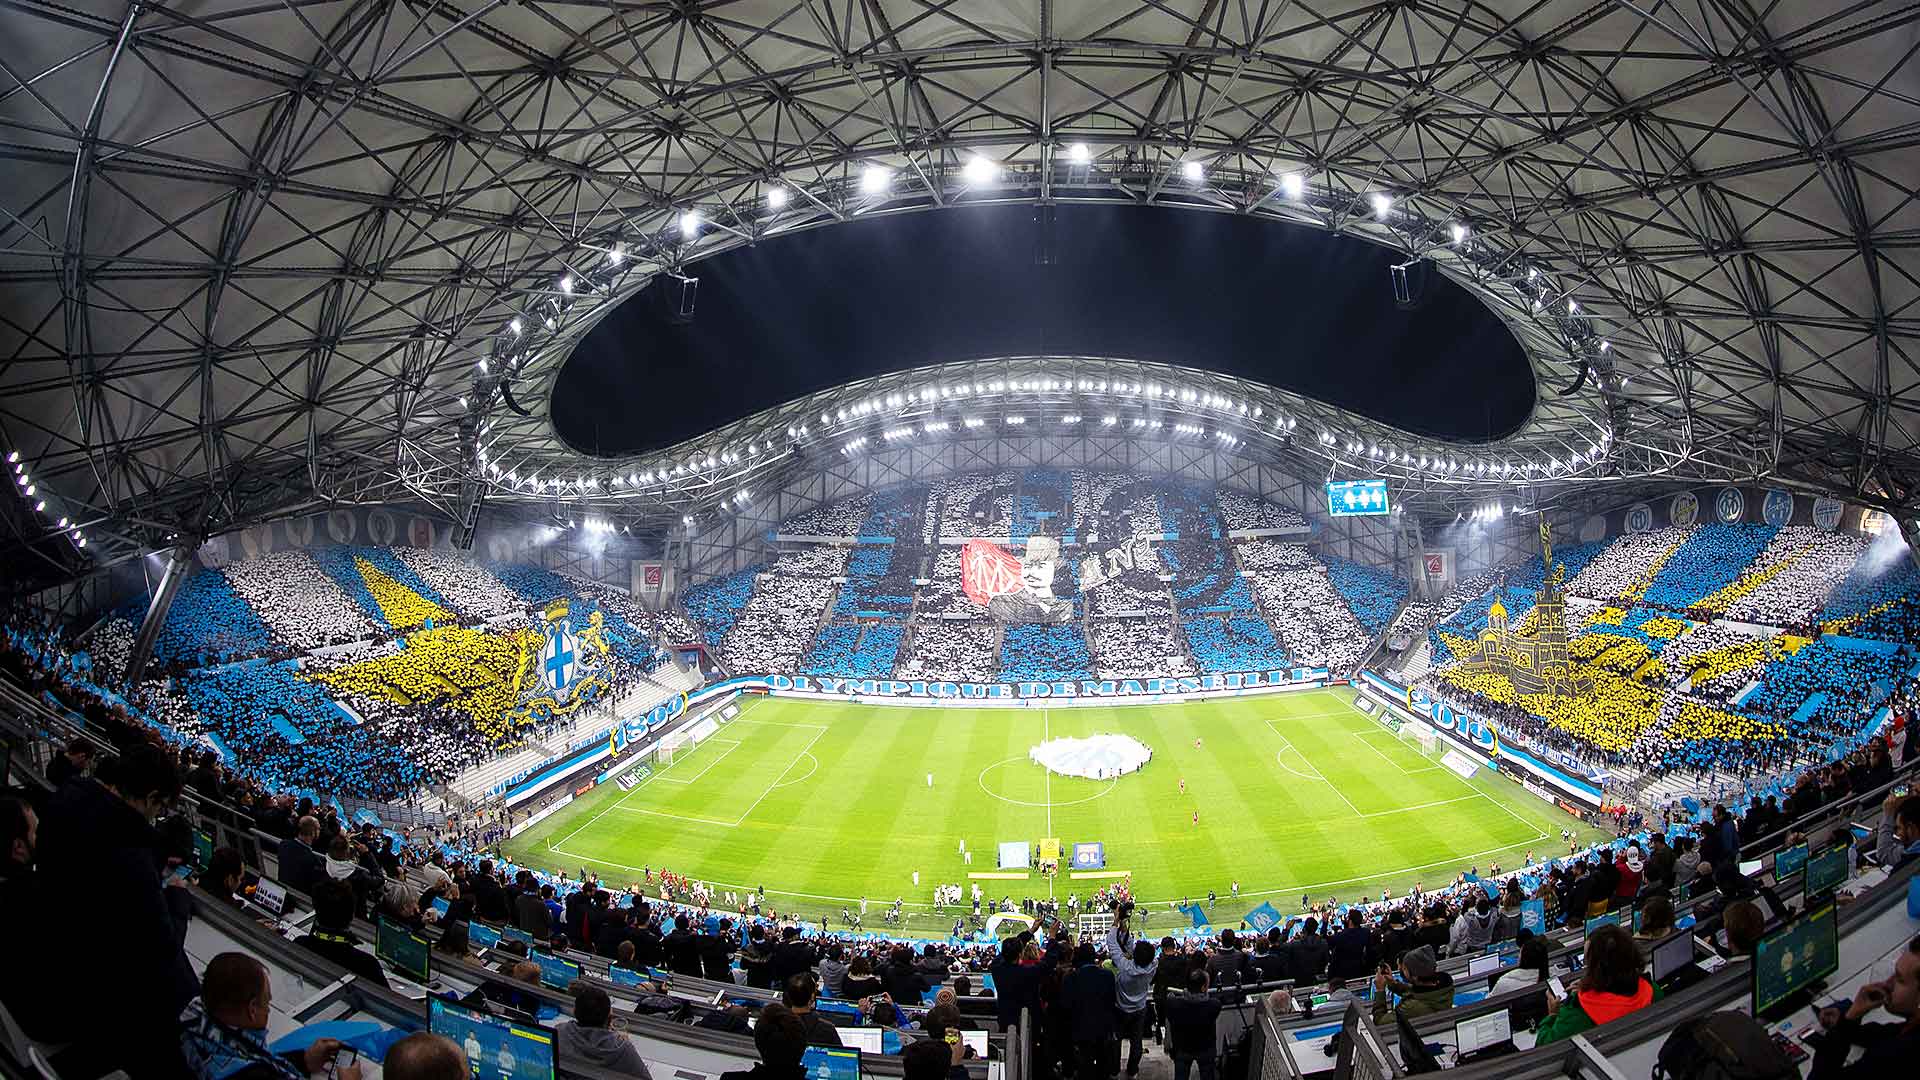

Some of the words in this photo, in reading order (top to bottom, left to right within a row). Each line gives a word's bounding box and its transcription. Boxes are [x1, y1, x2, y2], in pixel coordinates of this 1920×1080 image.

[1078, 530, 1151, 590] ANS
[763, 674, 1013, 699] OLYMPIQUE
[1018, 681, 1076, 698] DE
[1081, 666, 1313, 697] MARSEILLE
[614, 695, 685, 752] 1899
[1410, 690, 1495, 751] 2019
